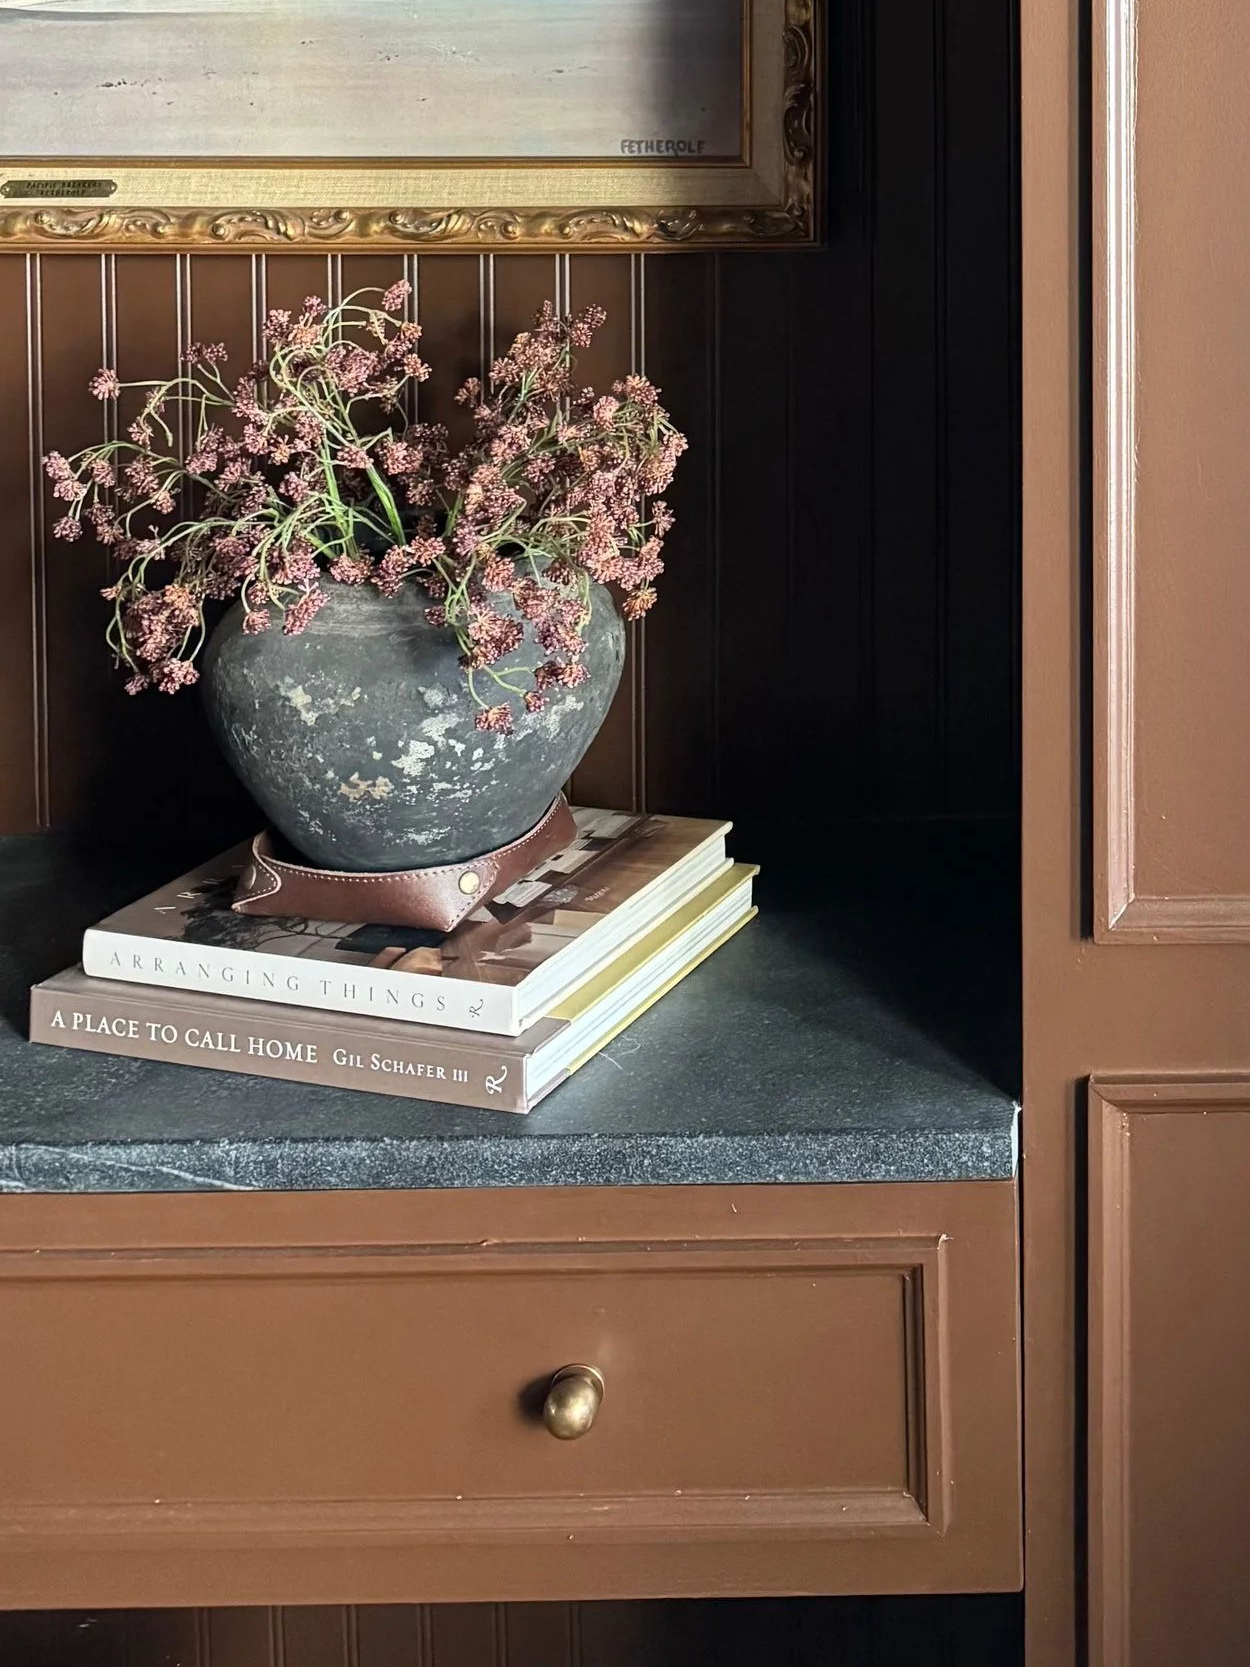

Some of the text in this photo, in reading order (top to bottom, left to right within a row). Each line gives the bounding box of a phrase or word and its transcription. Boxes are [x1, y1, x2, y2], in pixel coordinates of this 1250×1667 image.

[620, 139, 706, 157] FETHEROLF
[109, 950, 446, 1012] ARRANGING THINGS
[50, 1009, 66, 1029] A
[72, 1012, 139, 1038] PLACE
[145, 1022, 178, 1044] TO
[185, 1028, 241, 1053] CALL
[248, 1036, 319, 1063] HOME
[452, 1068, 469, 1083] III
